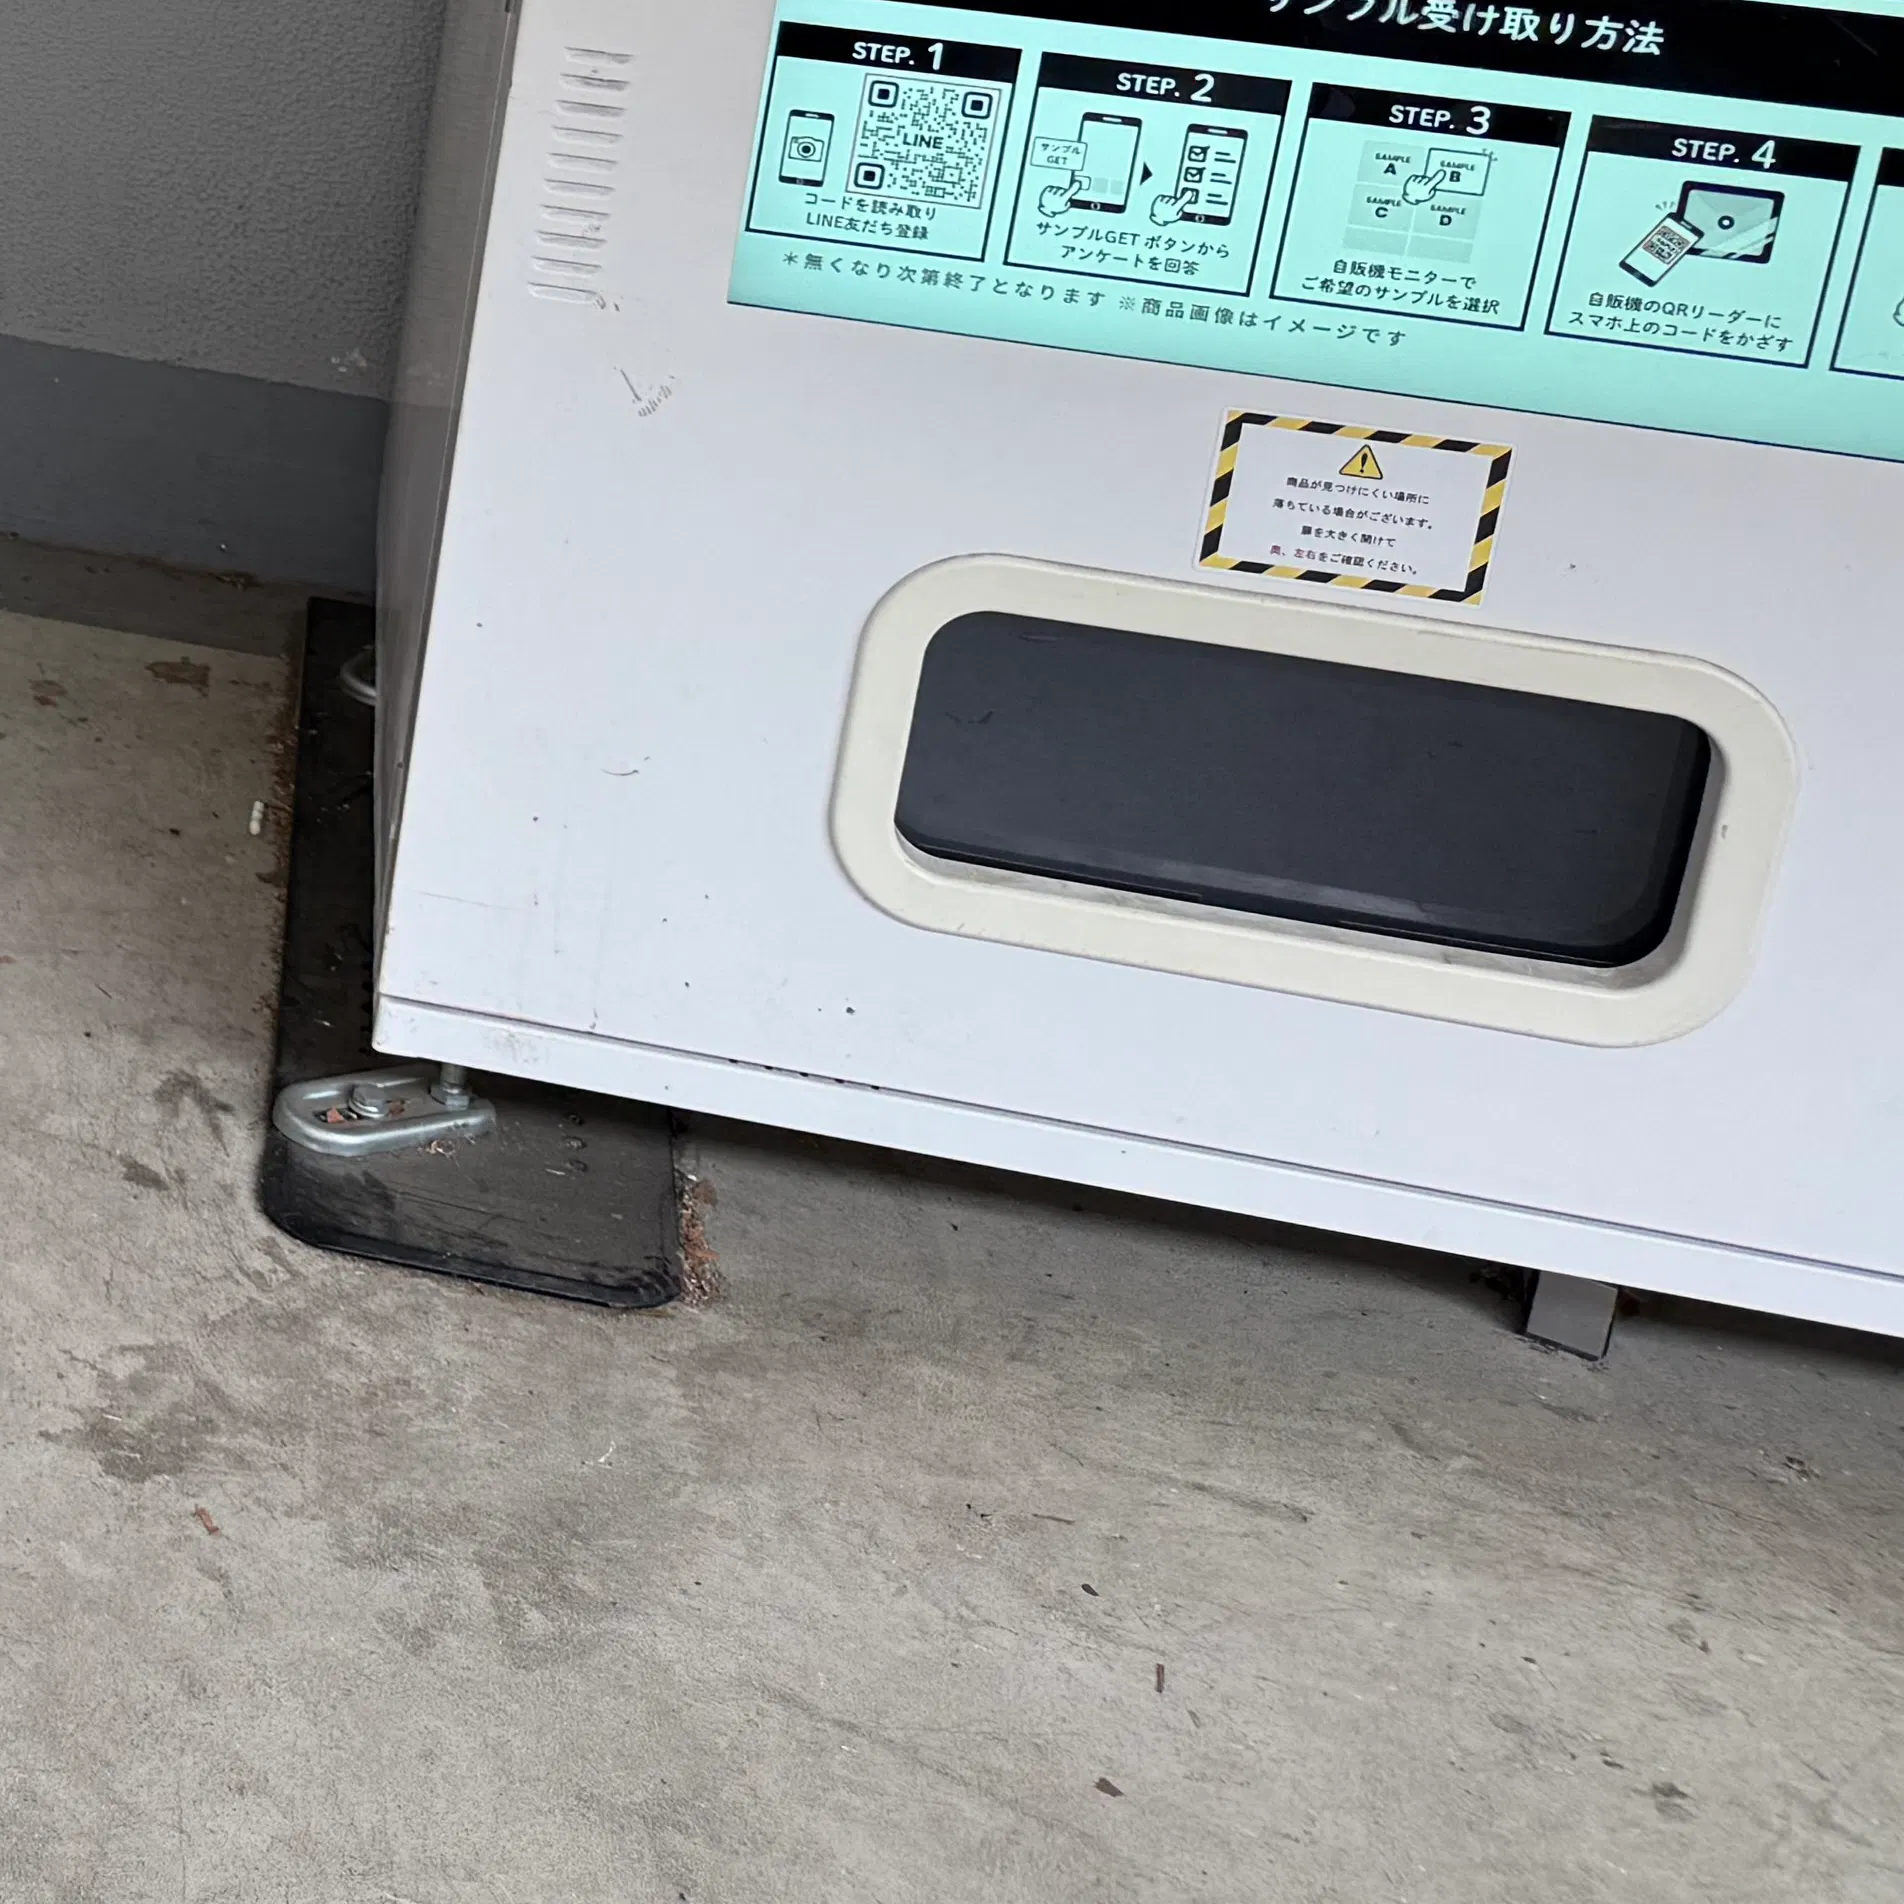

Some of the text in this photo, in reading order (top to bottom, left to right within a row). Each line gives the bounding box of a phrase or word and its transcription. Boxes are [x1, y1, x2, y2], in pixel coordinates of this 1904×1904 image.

[852, 40, 945, 70] STEP. 1
[1116, 70, 1217, 103] STEP. 2
[1388, 103, 1491, 136] STEP. 3
[901, 132, 944, 152] LINE
[1671, 137, 1778, 170] STEP. 4
[1383, 162, 1397, 176] A
[1449, 170, 1462, 183] B
[804, 191, 938, 222] コードを読み取り
[1374, 206, 1389, 219] C
[1439, 214, 1453, 227] D
[805, 212, 930, 242] LINE友だち登録
[1036, 220, 1231, 259] サンプルGET ボタンから
[1060, 244, 1202, 277] アンケートを回答
[1332, 257, 1478, 291] 自販機モニターで
[1300, 272, 1501, 316] ご希望のサンプルを選択
[1587, 290, 1783, 331] 自販機のQRリーダーに
[1568, 309, 1794, 353] スマホ上のコードをかざす
[1285, 475, 1431, 506] 商品が見つけにくい場所に
[1271, 496, 1435, 531] 落ちている場合がございます。
[1299, 523, 1398, 549] 扉を大きく開けて
